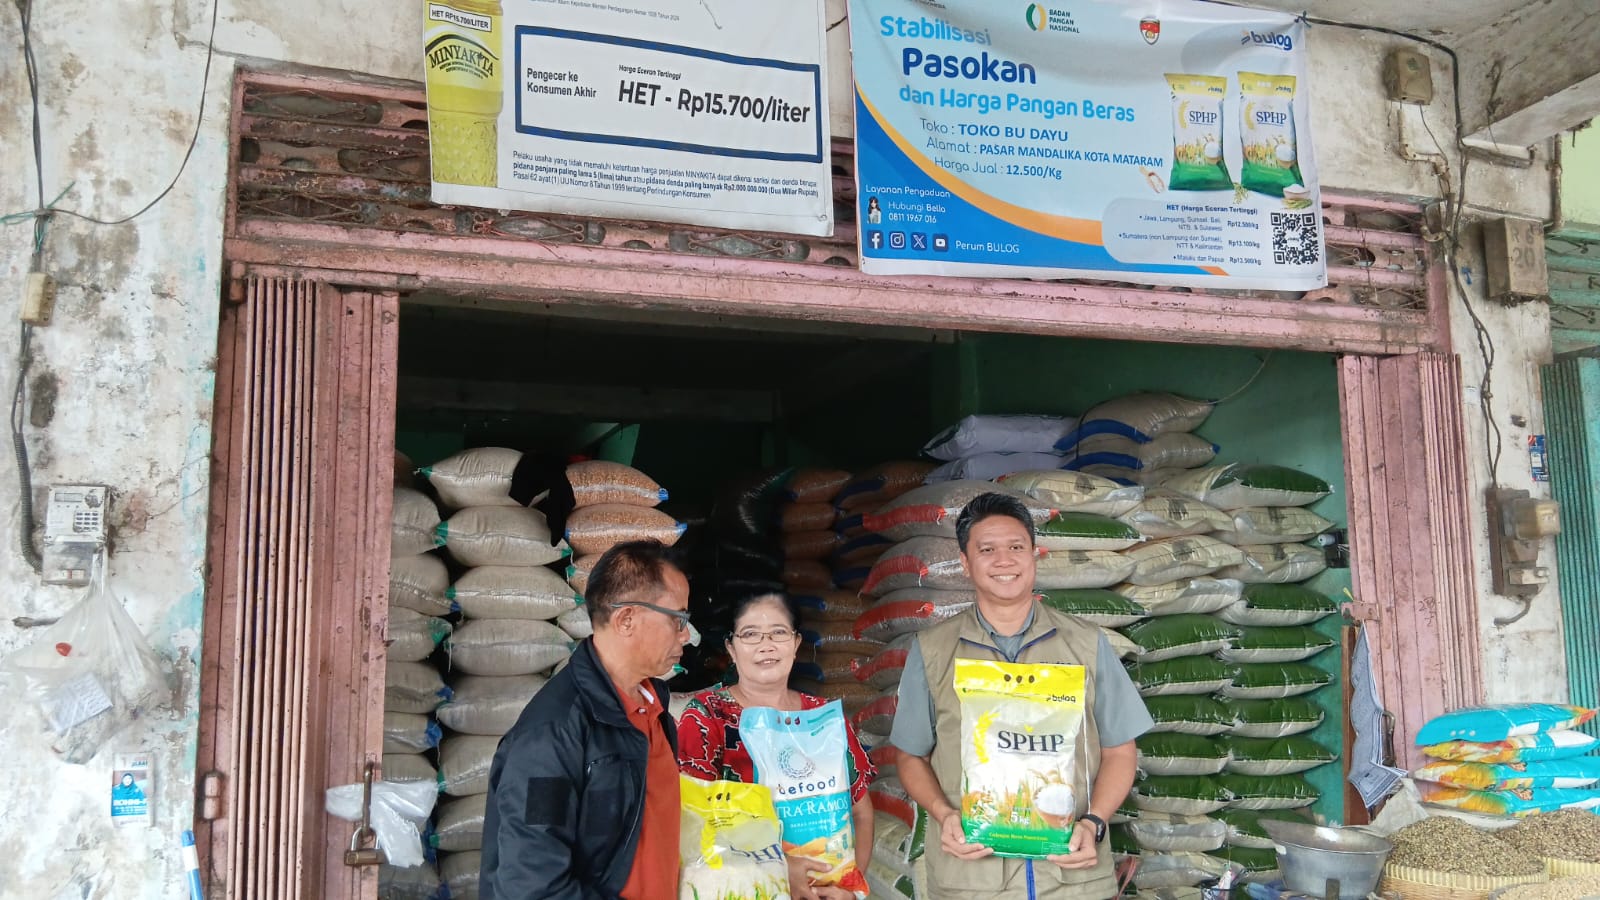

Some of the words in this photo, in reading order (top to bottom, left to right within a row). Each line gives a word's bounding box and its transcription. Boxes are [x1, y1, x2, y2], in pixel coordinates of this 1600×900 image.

[432, 10, 444, 18] HET
[1050, 9, 1071, 18] BADAN
[1050, 17, 1075, 26] PANGAN
[880, 15, 992, 46] Stabilisasi
[1050, 25, 1080, 34] NASIONAL
[1251, 31, 1293, 51] bulog
[429, 45, 494, 77] MINYAKITA
[903, 48, 1037, 84] Pasokan
[527, 68, 567, 83] Pengecer
[568, 71, 579, 82] ke
[619, 64, 636, 74] Harga
[637, 66, 657, 76] Eceran
[657, 68, 682, 81] Tertinggi
[527, 82, 573, 98] Konsumen
[575, 86, 597, 98] Akhir
[618, 80, 662, 106] HET
[677, 88, 811, 124] Rp15.700/liter
[900, 85, 935, 107] dan
[940, 89, 1002, 114] Harga
[1007, 94, 1078, 120] Pangan
[1082, 100, 1136, 123] Beras
[1189, 110, 1218, 124] SPHP
[1256, 111, 1287, 125] SPHP
[920, 117, 948, 135] Toko
[958, 124, 1000, 137] TOKO
[1005, 126, 1025, 139] BU
[1030, 129, 1068, 142] DAYU
[926, 137, 971, 154] Alamat
[980, 144, 1015, 156] PASAR
[1018, 146, 1082, 161] MANDALIKA
[1084, 151, 1111, 163] KOTA
[1112, 154, 1164, 168] MATARAM
[513, 150, 533, 161] Pelaku
[534, 155, 552, 164] usaha
[553, 158, 568, 167] yang
[569, 159, 582, 167] tidak
[583, 161, 612, 170] mematuhi
[612, 163, 640, 172] ketentuan
[641, 165, 658, 176] harga
[658, 168, 685, 178] penjualan
[717, 173, 732, 183] dapat
[934, 157, 970, 174] Harga
[972, 161, 998, 174] Jual
[1006, 164, 1063, 180] 12.500/Kg
[513, 162, 534, 171] pidana
[535, 165, 558, 174] penjara
[558, 167, 578, 178] paling
[615, 174, 632, 182] tahun
[646, 176, 666, 188] pidana
[666, 179, 684, 188] denda
[684, 180, 702, 191] paling
[703, 182, 724, 192] banyak
[798, 188, 819, 198] Rupiah)
[513, 171, 530, 180] Pasal
[538, 175, 552, 185] ayat
[552, 175, 560, 185] (1)
[570, 178, 589, 188] Nomor
[594, 180, 610, 190] Tahun
[626, 185, 646, 195] tentang
[683, 188, 712, 199] Konsumen
[866, 185, 902, 195] Layanan
[905, 186, 951, 198] Pengaduan
[888, 202, 924, 212] Hubungi
[926, 202, 946, 214] Bella
[1181, 204, 1204, 213] (Harga
[1205, 206, 1228, 214] Eceran
[1229, 206, 1258, 216] Tertinggi)
[889, 213, 904, 222] 0811
[906, 214, 922, 223] 1967
[925, 215, 937, 224] 016
[1162, 234, 1188, 243] Lampung
[956, 241, 985, 251] Perum
[987, 242, 1020, 254] BULOG
[1052, 694, 1076, 704] bulog
[998, 730, 1064, 752] SPHP
[806, 796, 849, 815] RAMOS
[1011, 812, 1018, 823] 5
